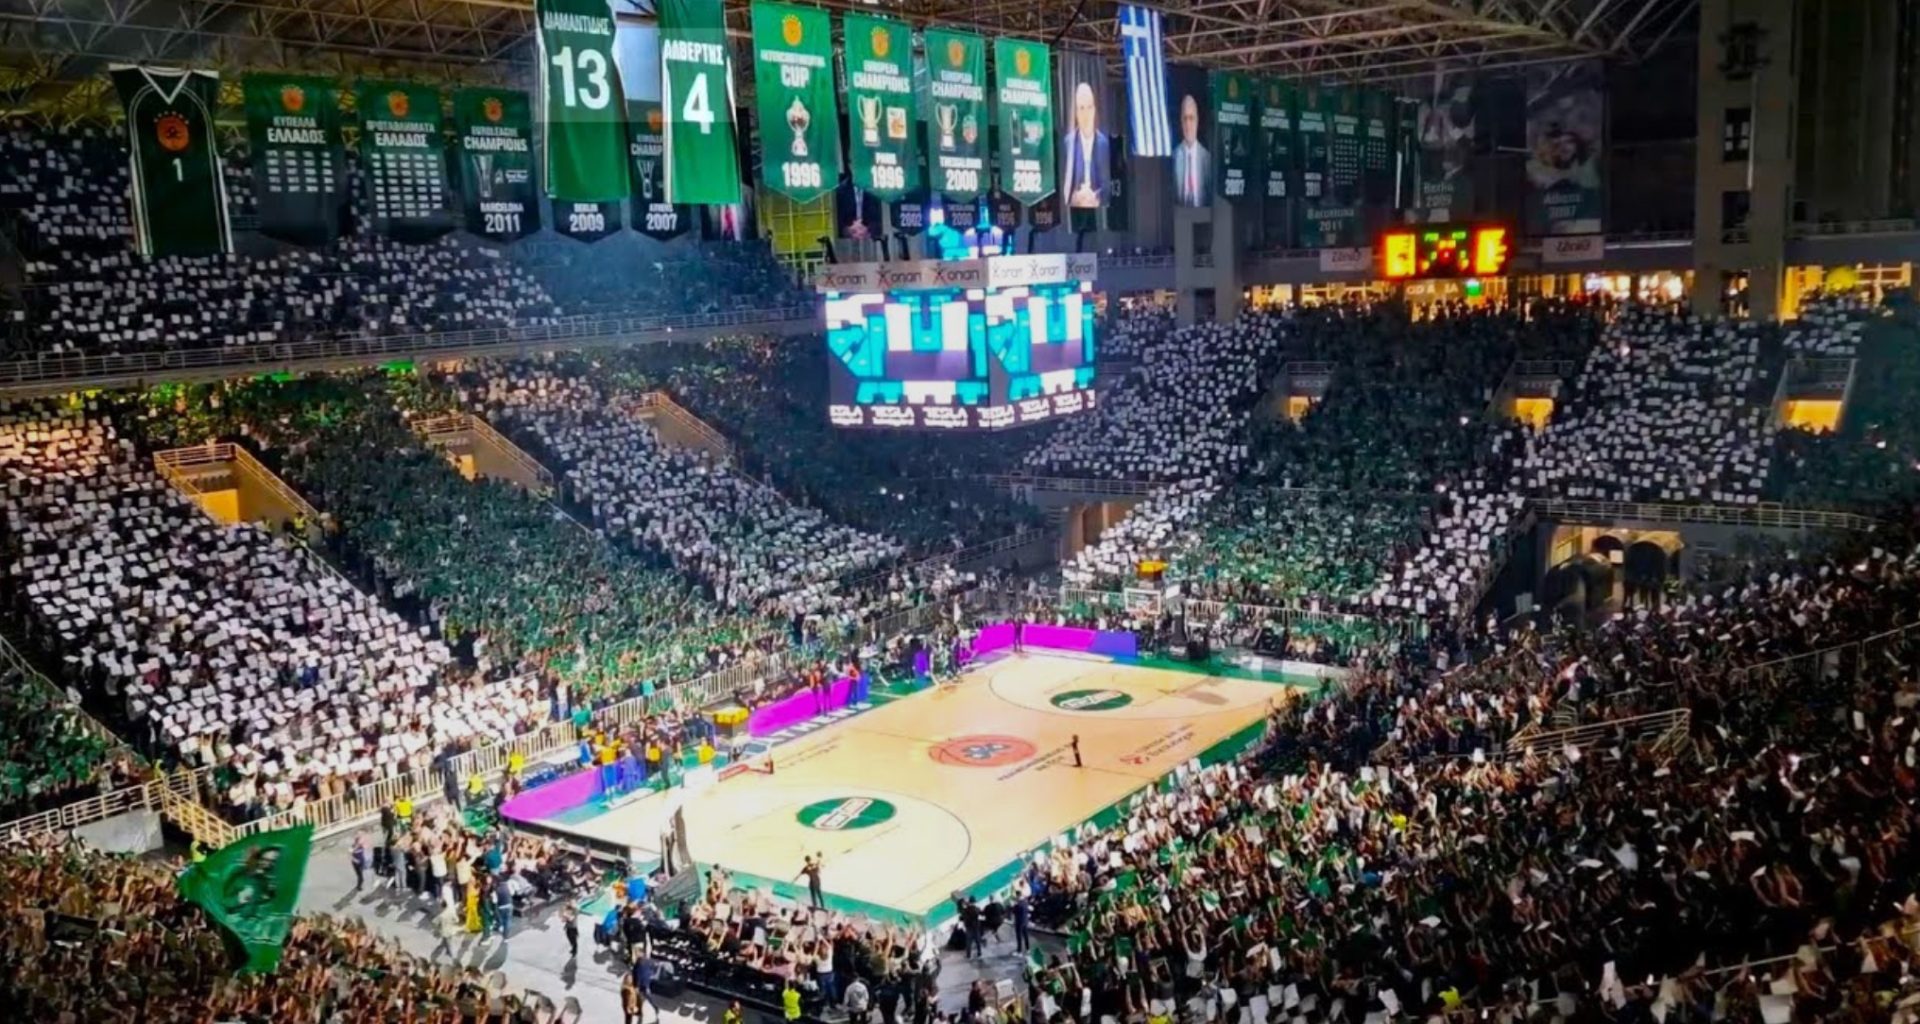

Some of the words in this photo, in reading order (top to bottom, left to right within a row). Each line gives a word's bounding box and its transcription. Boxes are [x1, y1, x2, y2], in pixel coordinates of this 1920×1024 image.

[552, 46, 610, 110] 13
[781, 64, 810, 88] CUP
[853, 72, 910, 93] CHAMPIONS
[932, 81, 982, 101] CHAMPIONS
[683, 72, 715, 134] 4
[267, 127, 326, 144] ΕΛΛΑΔΟΣ
[375, 132, 429, 147] ΕΛΛΑΔΟΣ
[464, 136, 528, 151] CHAMPIONS
[172, 158, 184, 182] 1
[782, 162, 821, 187] 1996
[871, 165, 904, 188] 1996
[946, 170, 978, 192] 2000
[1012, 172, 1042, 192] 2002
[484, 214, 521, 233] 2011
[569, 213, 605, 232] 2009
[646, 213, 678, 231] 2007
